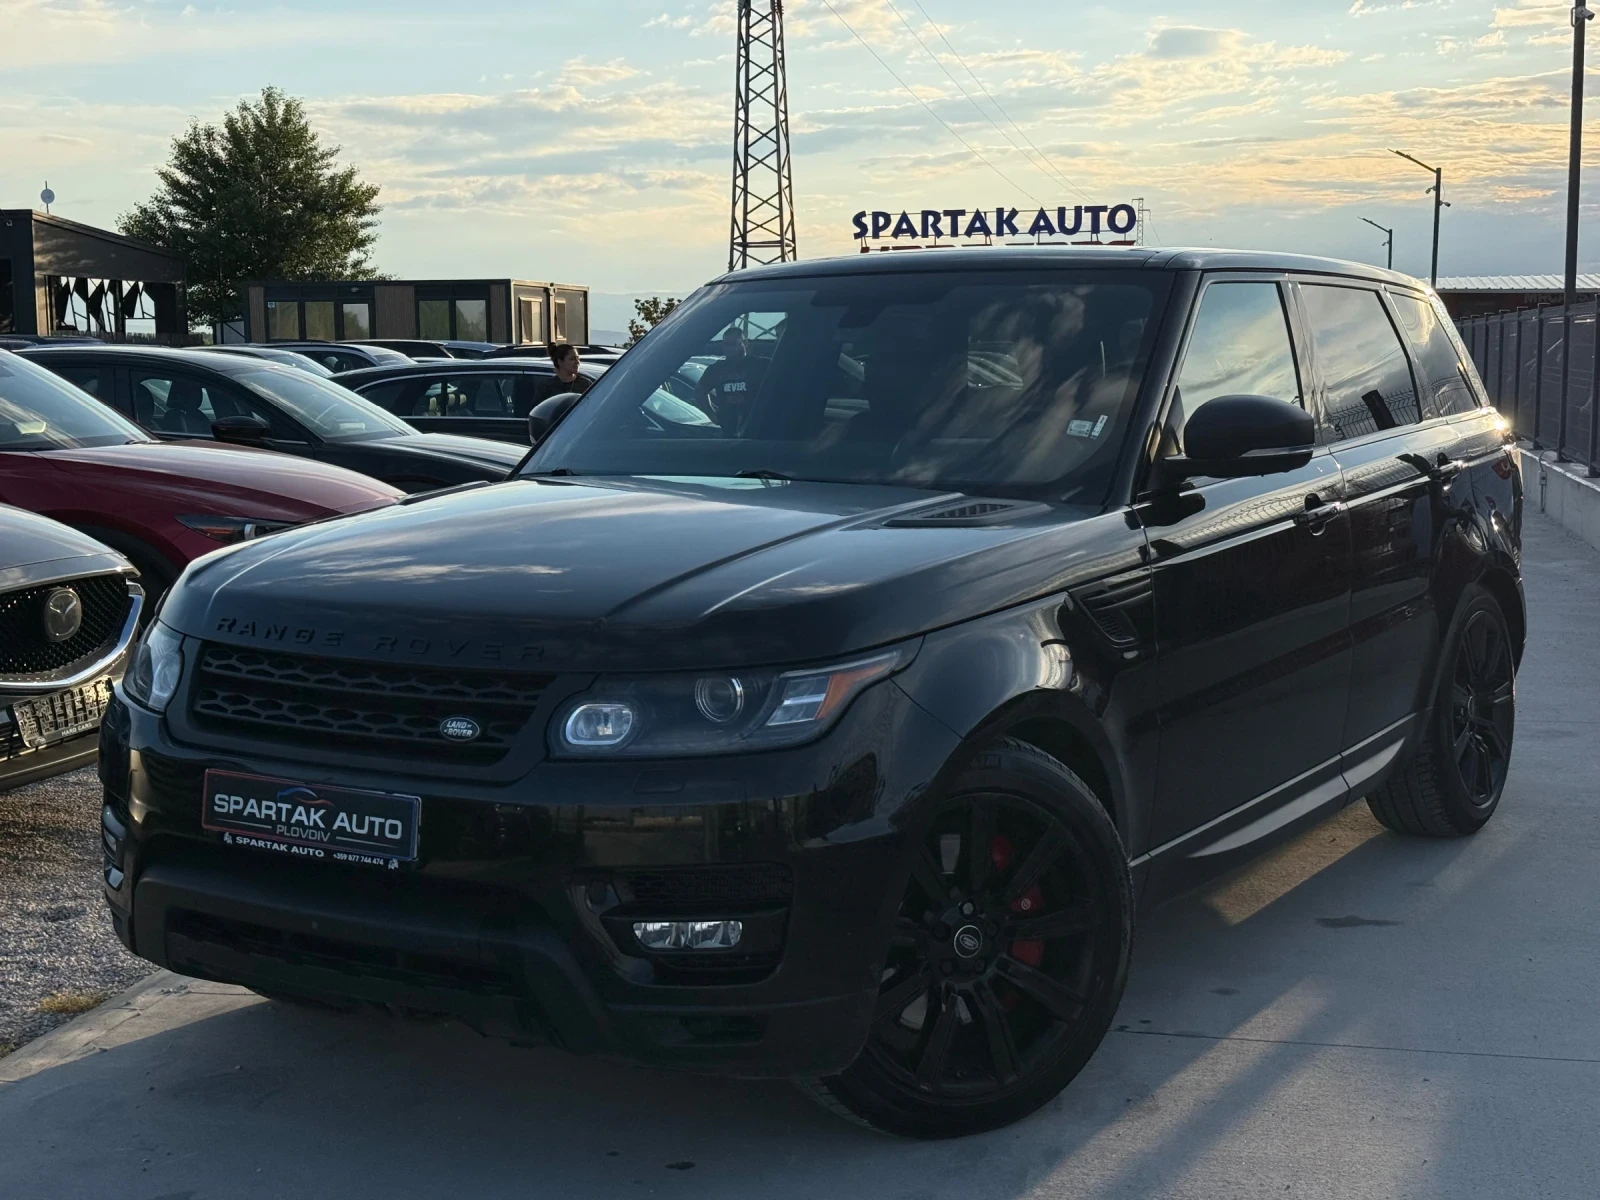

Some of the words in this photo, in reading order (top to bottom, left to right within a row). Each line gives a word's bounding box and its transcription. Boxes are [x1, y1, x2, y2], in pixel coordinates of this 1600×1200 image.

[852, 207, 1020, 239] SPARTAK
[1028, 203, 1136, 237] AUTO
[216, 617, 345, 647] RANGE
[374, 635, 546, 663] ROVER
[447, 728, 473, 737] ROVER
[213, 793, 327, 829] SPARTAK
[332, 812, 403, 840] AUTO
[235, 836, 288, 852] SPARTAK
[290, 846, 325, 858] AUTO
[276, 825, 331, 842] PLOVDIV
